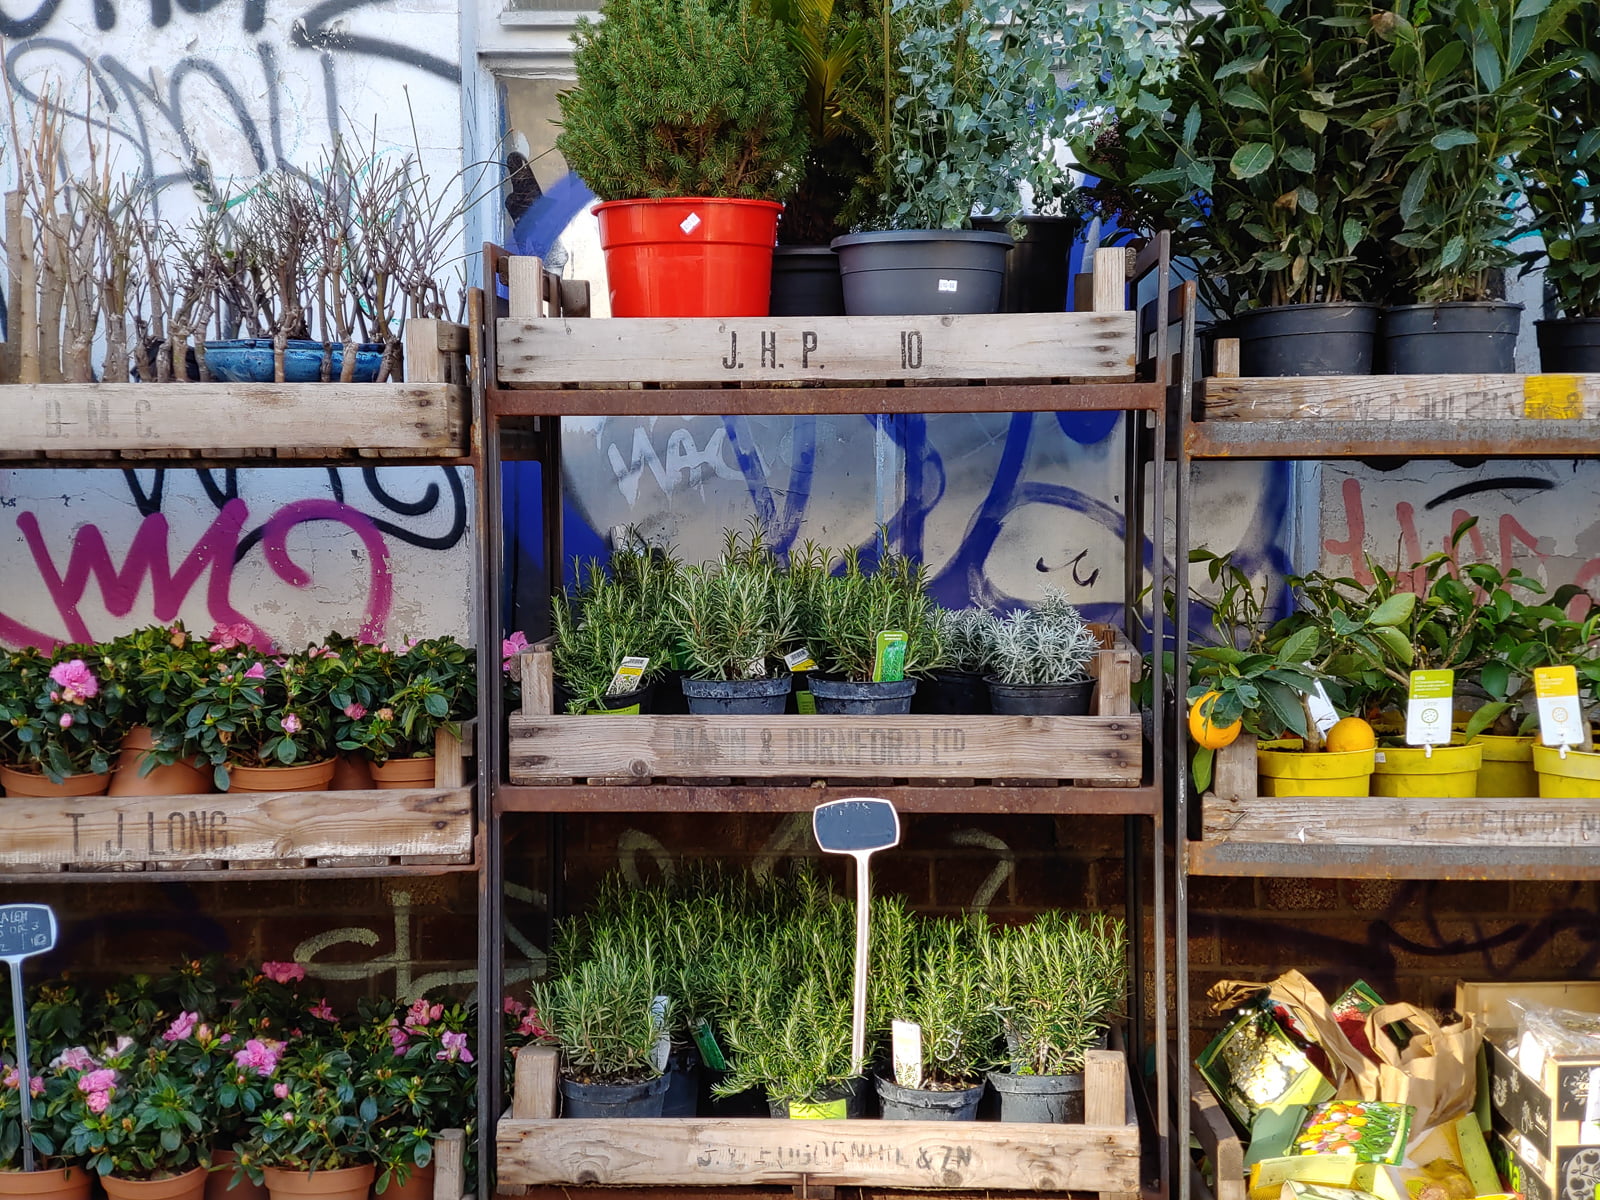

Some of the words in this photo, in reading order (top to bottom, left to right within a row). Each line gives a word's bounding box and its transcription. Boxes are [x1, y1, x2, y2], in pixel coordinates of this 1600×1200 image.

[722, 331, 744, 369] J.
[761, 331, 785, 369] H.
[802, 331, 825, 369] P.
[900, 330, 923, 369] 10
[759, 728, 776, 766] &
[787, 728, 921, 766] DURNFORD
[65, 812, 95, 857] T.
[104, 813, 132, 857] J.
[147, 810, 228, 857] LONG
[916, 1146, 933, 1170] &
